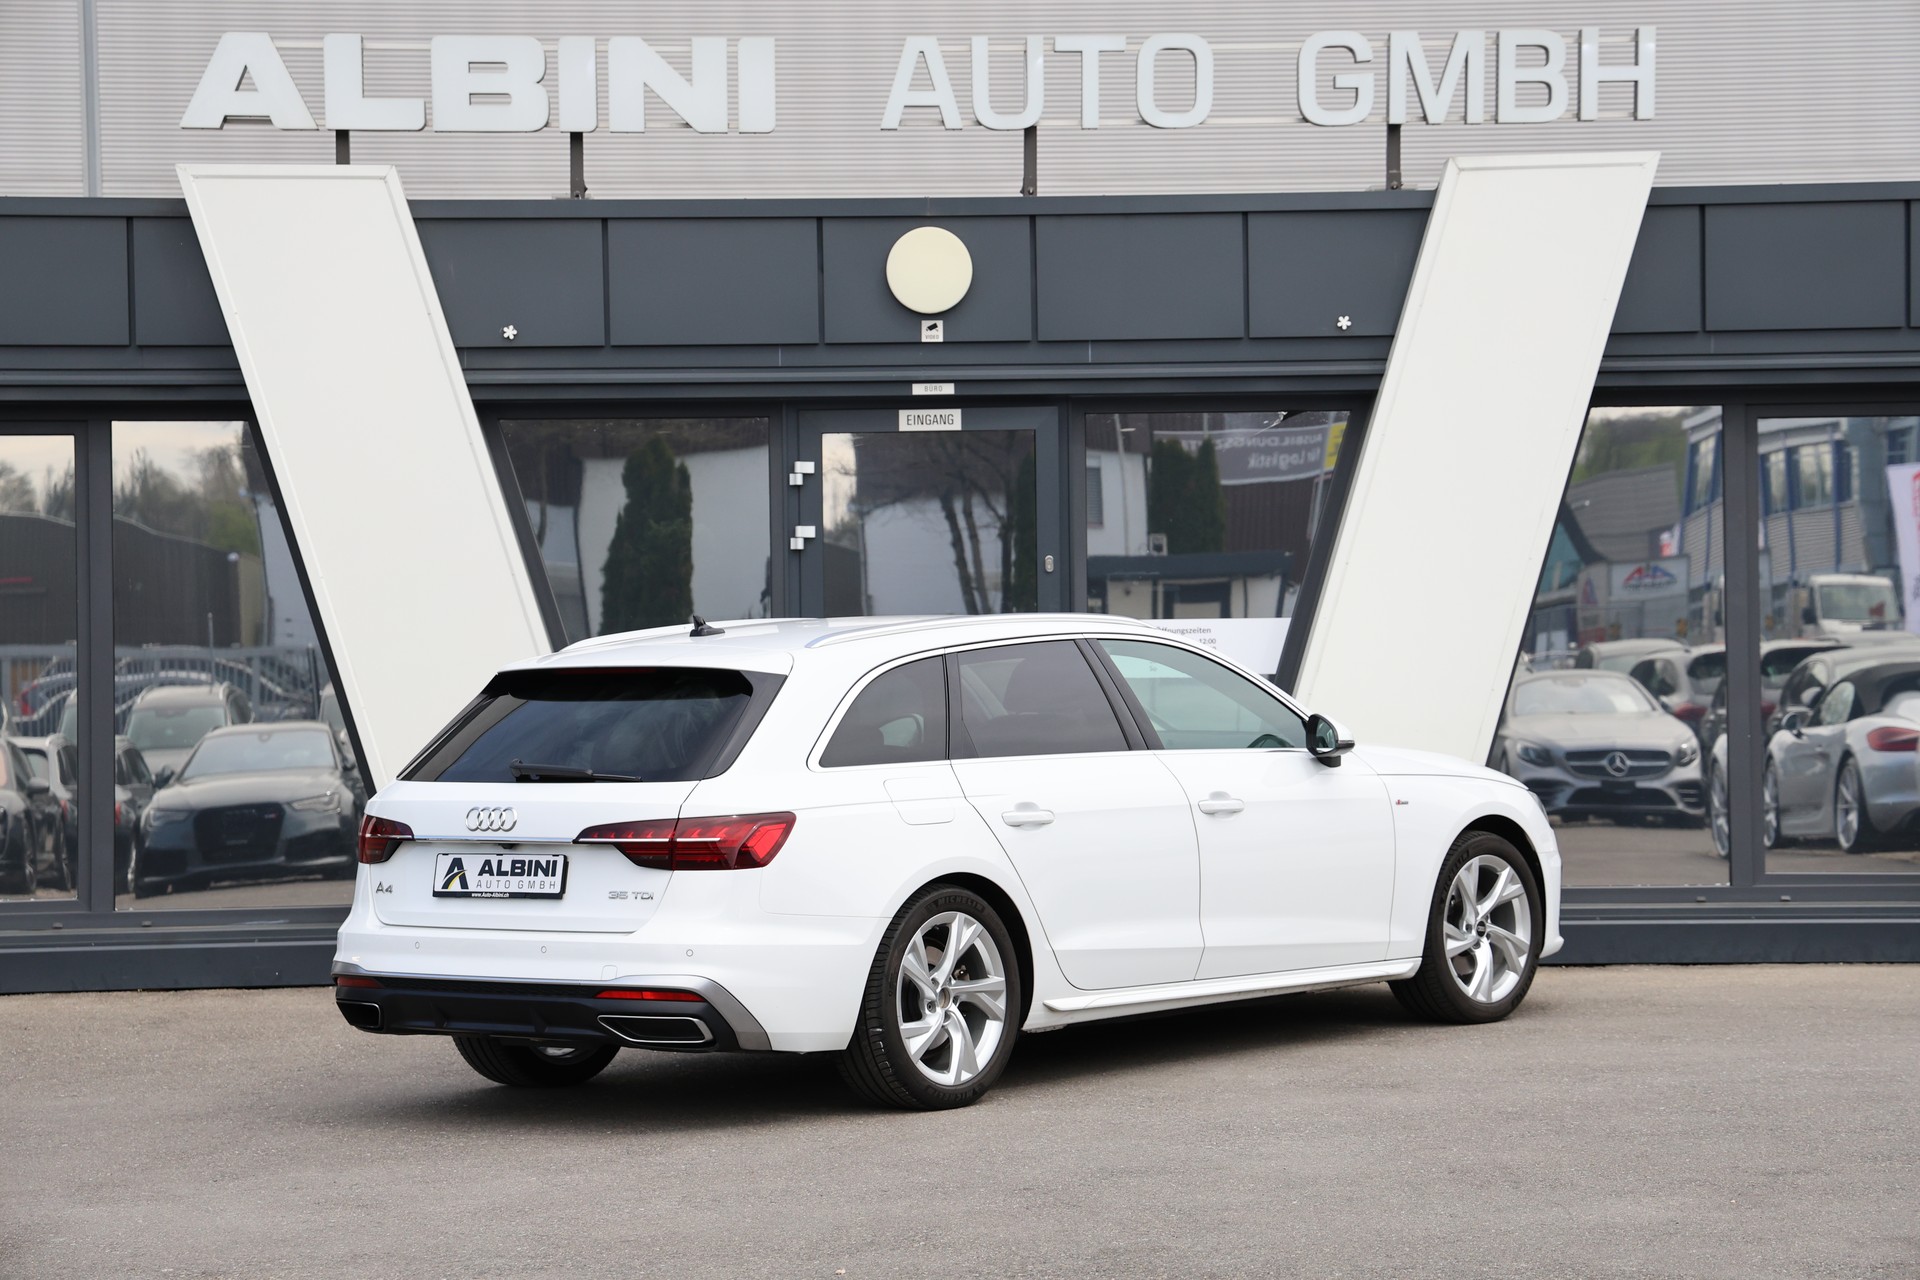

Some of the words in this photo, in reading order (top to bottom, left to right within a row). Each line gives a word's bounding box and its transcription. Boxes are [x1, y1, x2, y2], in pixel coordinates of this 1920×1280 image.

[180, 32, 776, 134] ALBINI
[880, 33, 1214, 130] AUTO
[1296, 26, 1657, 126] GMBH
[924, 384, 943, 392] BÜRO
[906, 413, 954, 426] EINGANG
[477, 859, 558, 877] ALBINI
[375, 880, 393, 894] A4
[476, 880, 511, 889] AUTO
[517, 880, 556, 890] GMBH
[608, 891, 628, 900] 35
[631, 891, 654, 900] TDI
